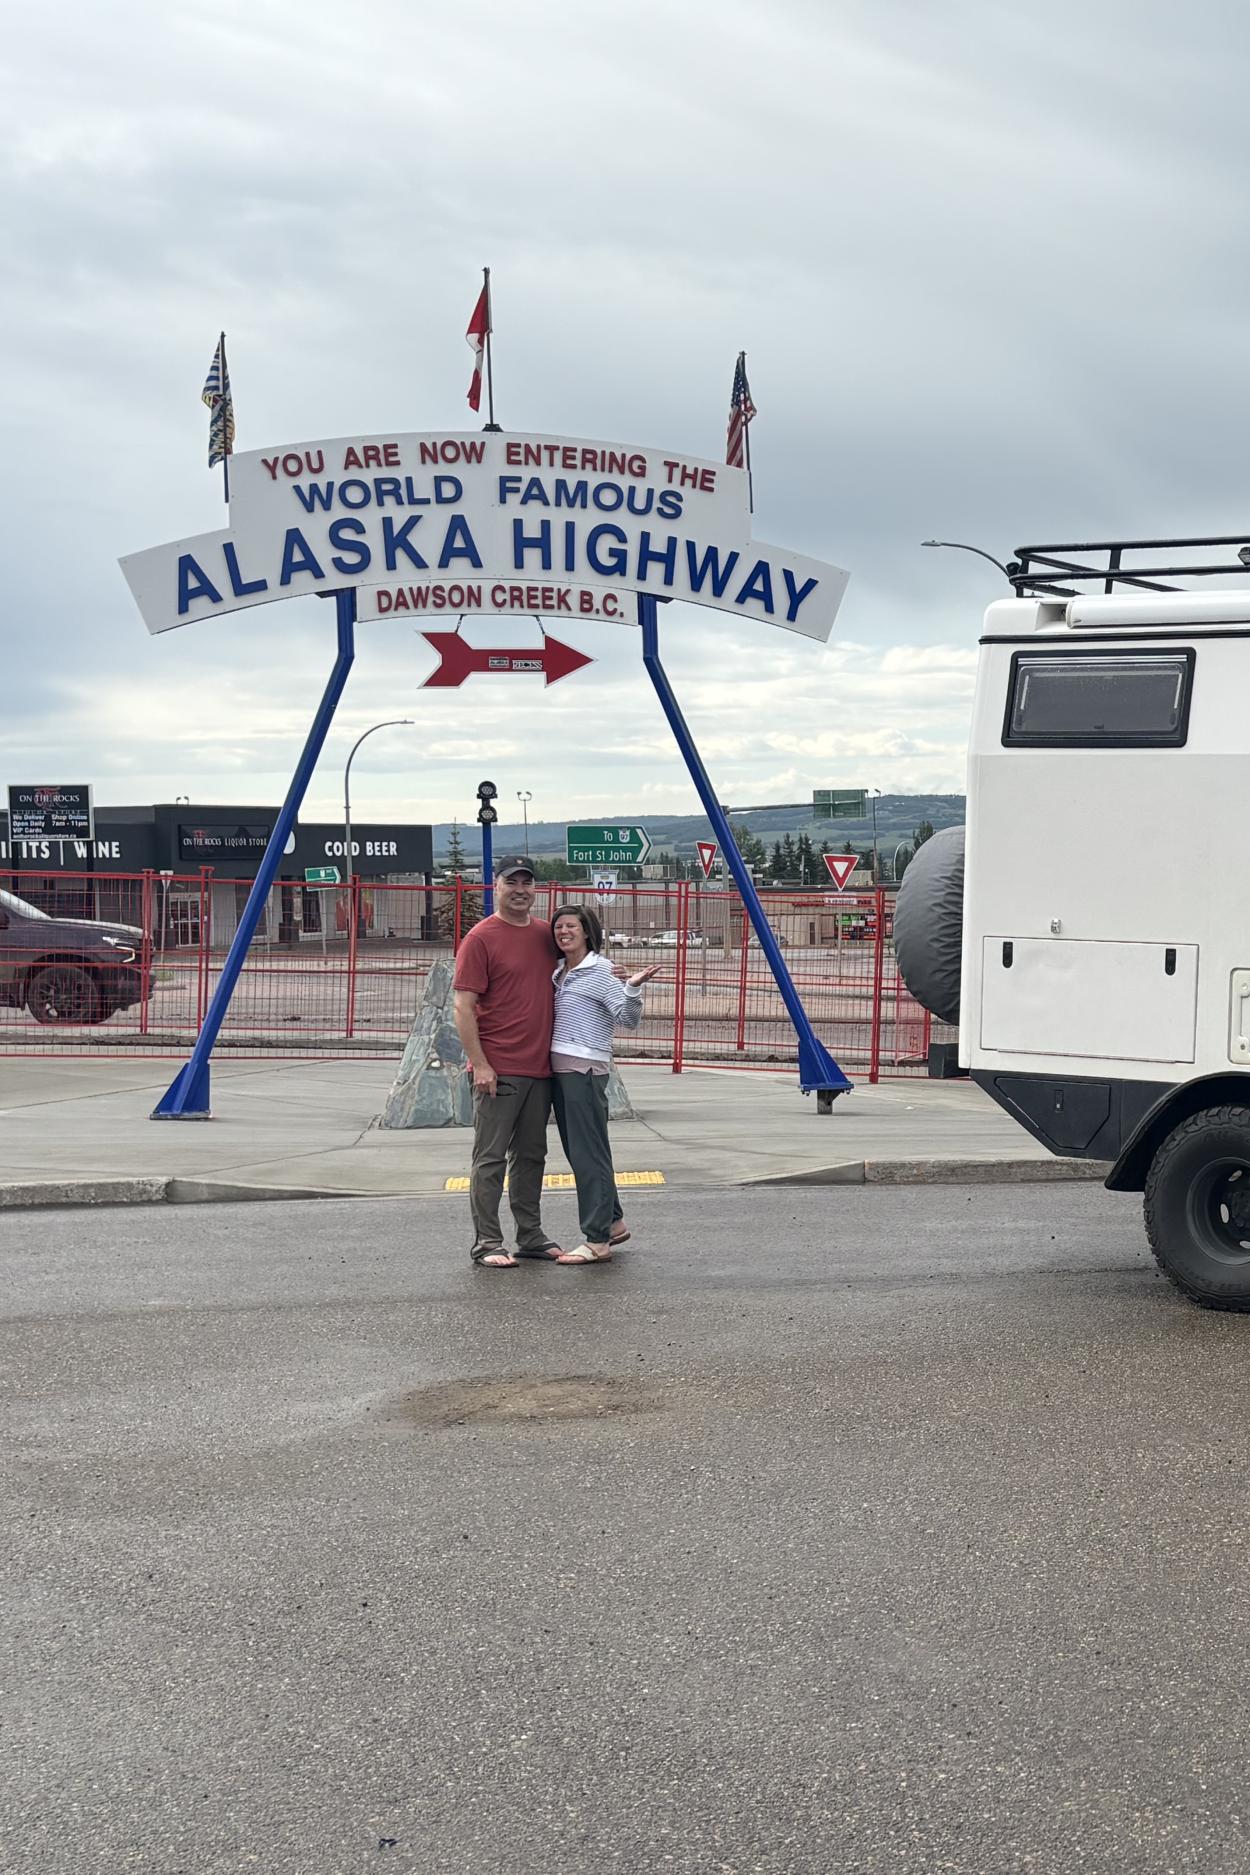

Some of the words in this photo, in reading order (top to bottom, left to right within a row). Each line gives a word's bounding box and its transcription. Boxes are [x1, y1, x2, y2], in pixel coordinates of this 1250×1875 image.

[261, 450, 325, 480] YOU
[343, 443, 401, 470] ARE
[419, 440, 486, 465] NOW
[506, 442, 647, 478] ENTERING
[663, 460, 717, 493] THE
[292, 475, 463, 513] WORLD
[498, 475, 683, 520] FAMOUS
[177, 514, 484, 615] ALASKA
[512, 518, 819, 622] HIGHWAY
[376, 584, 482, 614] DAWSON
[490, 584, 572, 612] CREEK
[579, 591, 625, 618] B.C.
[53, 794, 80, 802] ROCKS
[30, 820, 46, 828] Daily
[224, 837, 247, 847] LIQUOR
[603, 831, 613, 841] To
[73, 841, 121, 858] WINE
[366, 841, 398, 856] BEER
[573, 849, 592, 861] Fort
[596, 849, 606, 861] St
[609, 849, 632, 861] John
